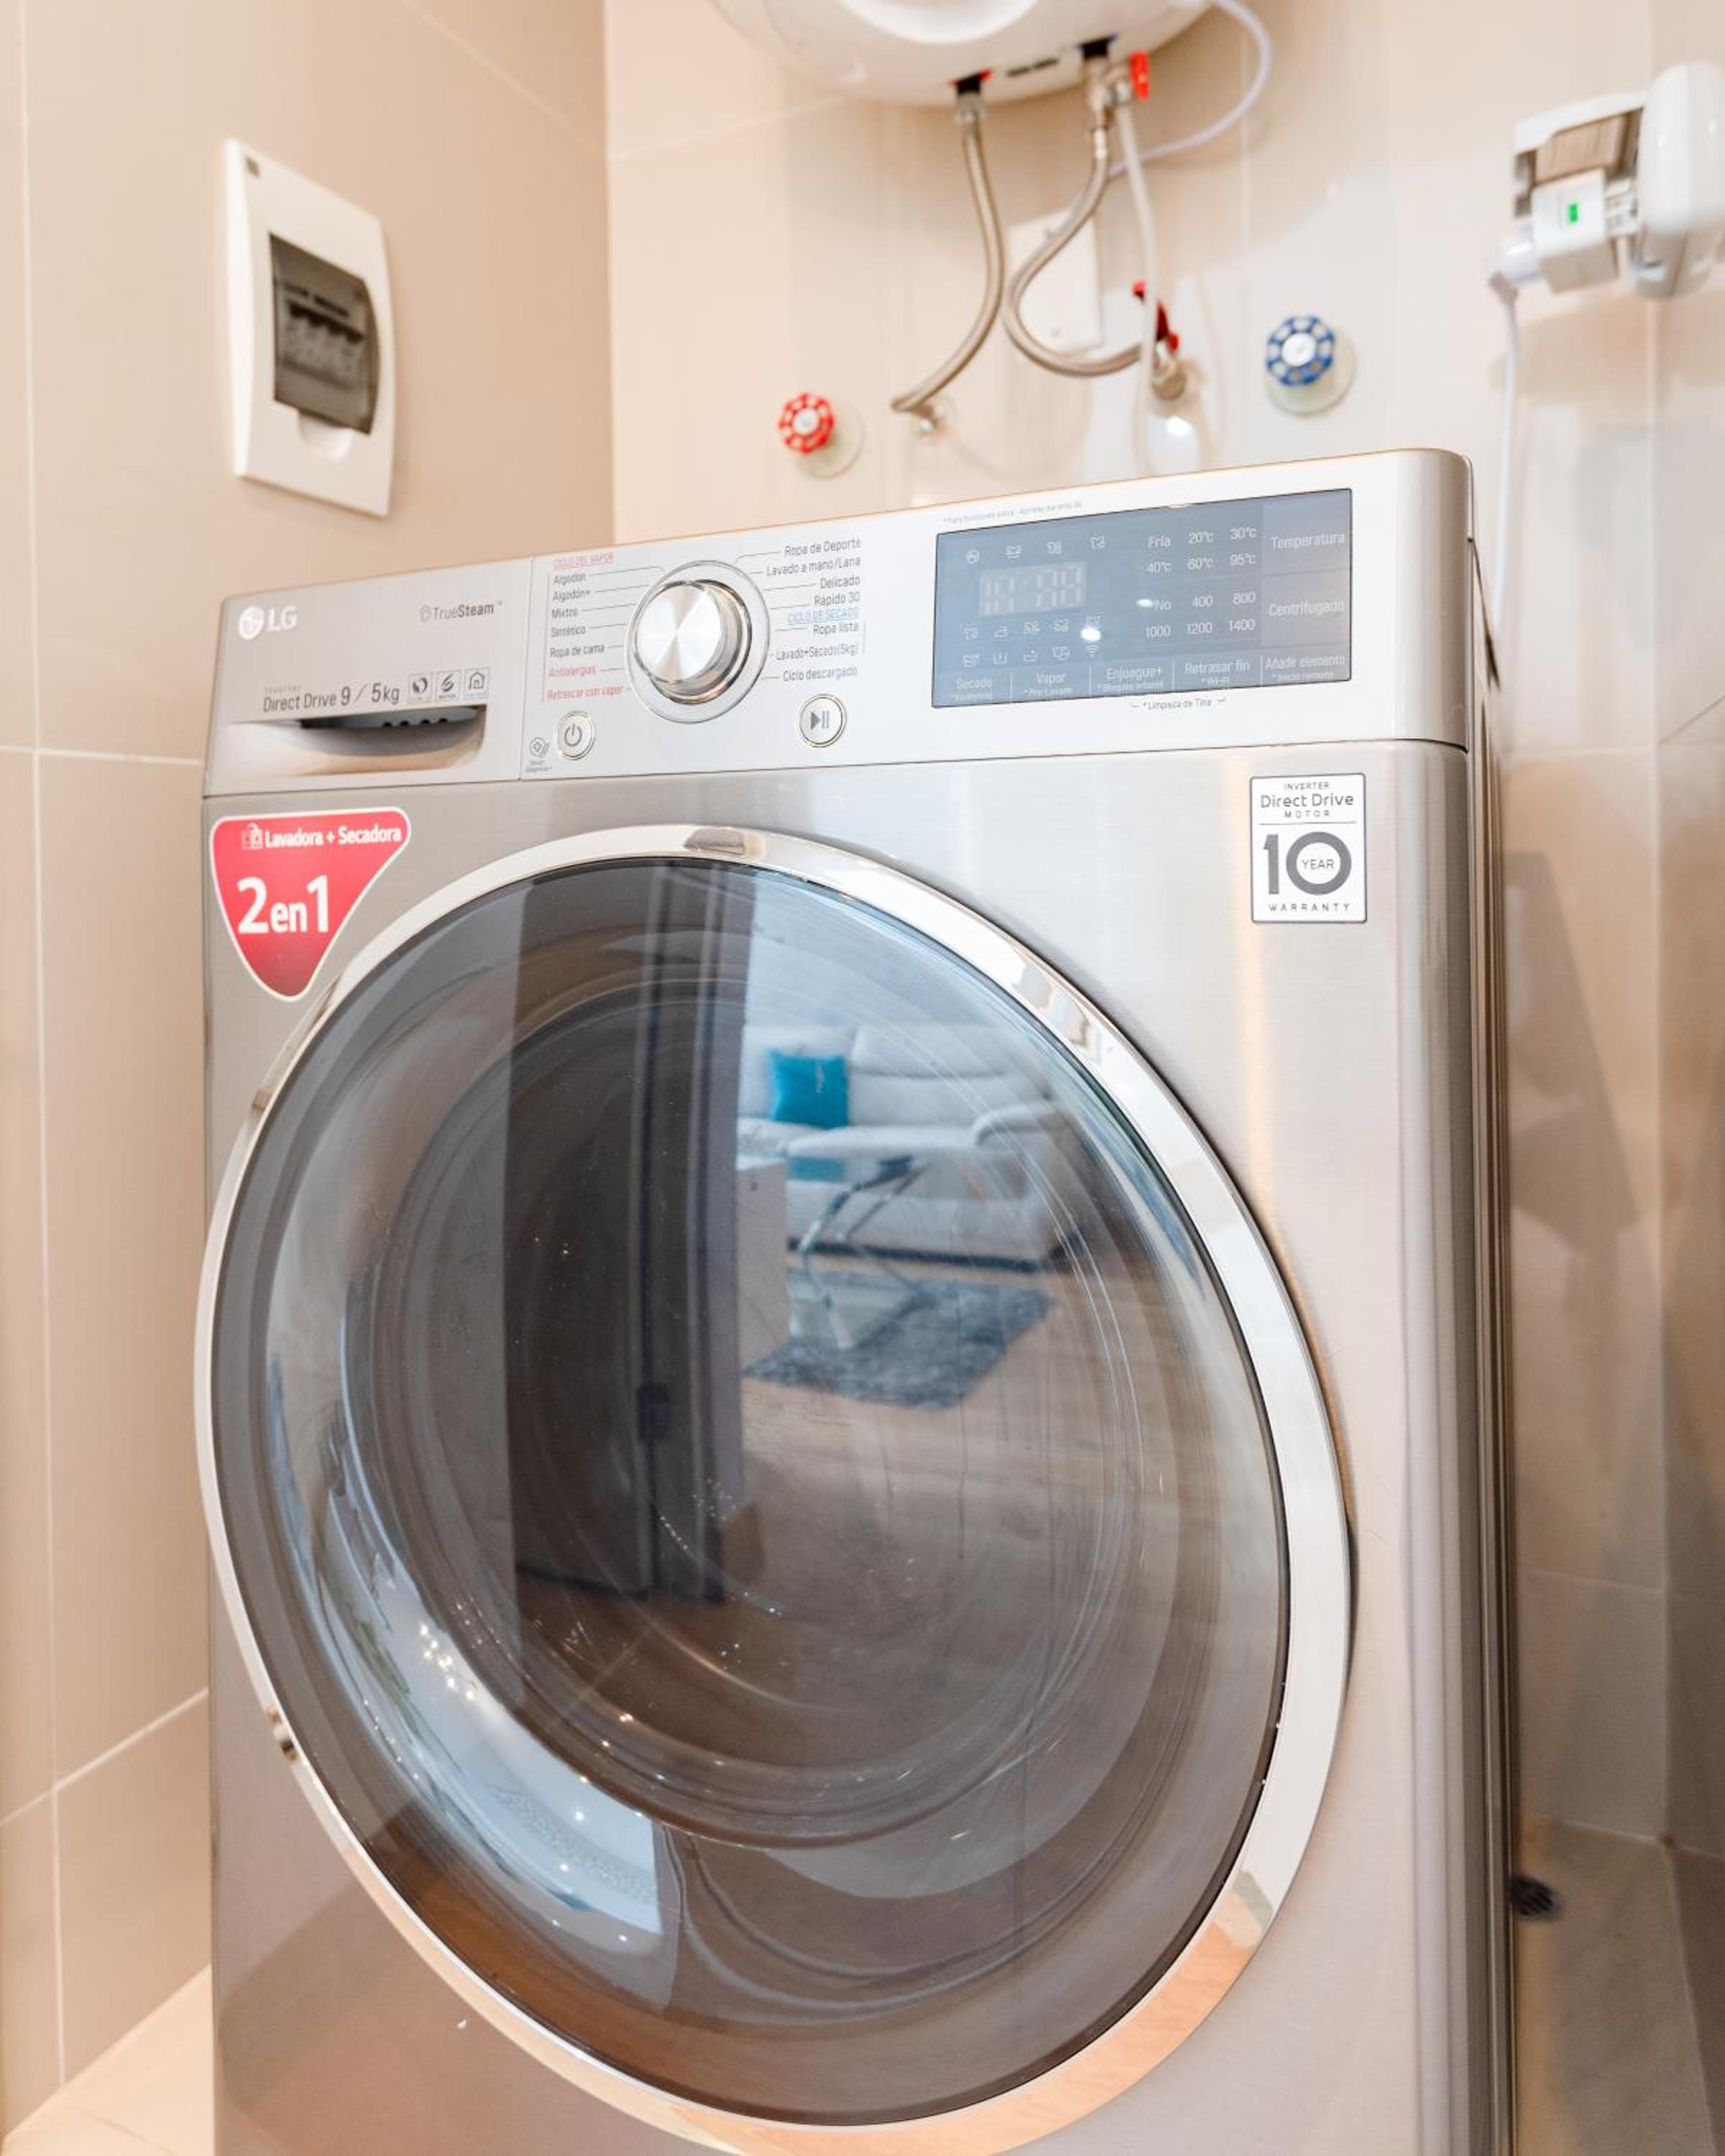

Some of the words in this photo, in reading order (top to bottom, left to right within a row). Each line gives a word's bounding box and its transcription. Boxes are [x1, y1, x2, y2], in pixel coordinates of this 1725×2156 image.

[784, 545, 809, 557] Ropa
[810, 543, 820, 554] de
[824, 538, 862, 553] Deporte
[1271, 533, 1346, 549] Temperatura
[767, 563, 799, 576] Lavado
[809, 557, 861, 572] mano/Lana
[820, 576, 860, 589] Delicado
[848, 591, 860, 602] 30
[1192, 595, 1213, 607] 400
[1233, 591, 1256, 605] 800
[1269, 599, 1345, 617] Centrifugado
[267, 605, 298, 632] LG
[434, 604, 494, 620] TrueSteam
[1146, 625, 1171, 638] 1000
[1187, 622, 1213, 635] 1200
[1229, 618, 1255, 632] 1400
[550, 647, 570, 658] Ropa
[571, 646, 581, 655] de
[583, 645, 604, 655] cama
[1107, 667, 1162, 681] Enjuague+
[1185, 662, 1230, 674] Retrasar
[1236, 659, 1250, 673] fin
[783, 671, 804, 682] Ciclo
[1036, 673, 1066, 686] Vapor
[263, 696, 300, 712] Direct
[303, 692, 337, 708] Drive
[341, 686, 351, 706] 9
[371, 682, 400, 705] 5kg
[1284, 781, 1329, 791] INVERTER
[1261, 793, 1307, 808] Direct
[1312, 793, 1353, 807] Drive
[1284, 809, 1330, 818] MOTOR
[265, 827, 323, 848] Lavadora
[326, 831, 334, 844] +
[338, 823, 402, 845] Secadora
[1263, 831, 1352, 895] 10
[1302, 859, 1335, 870] YEAR
[1268, 903, 1350, 913] WARRANTY
